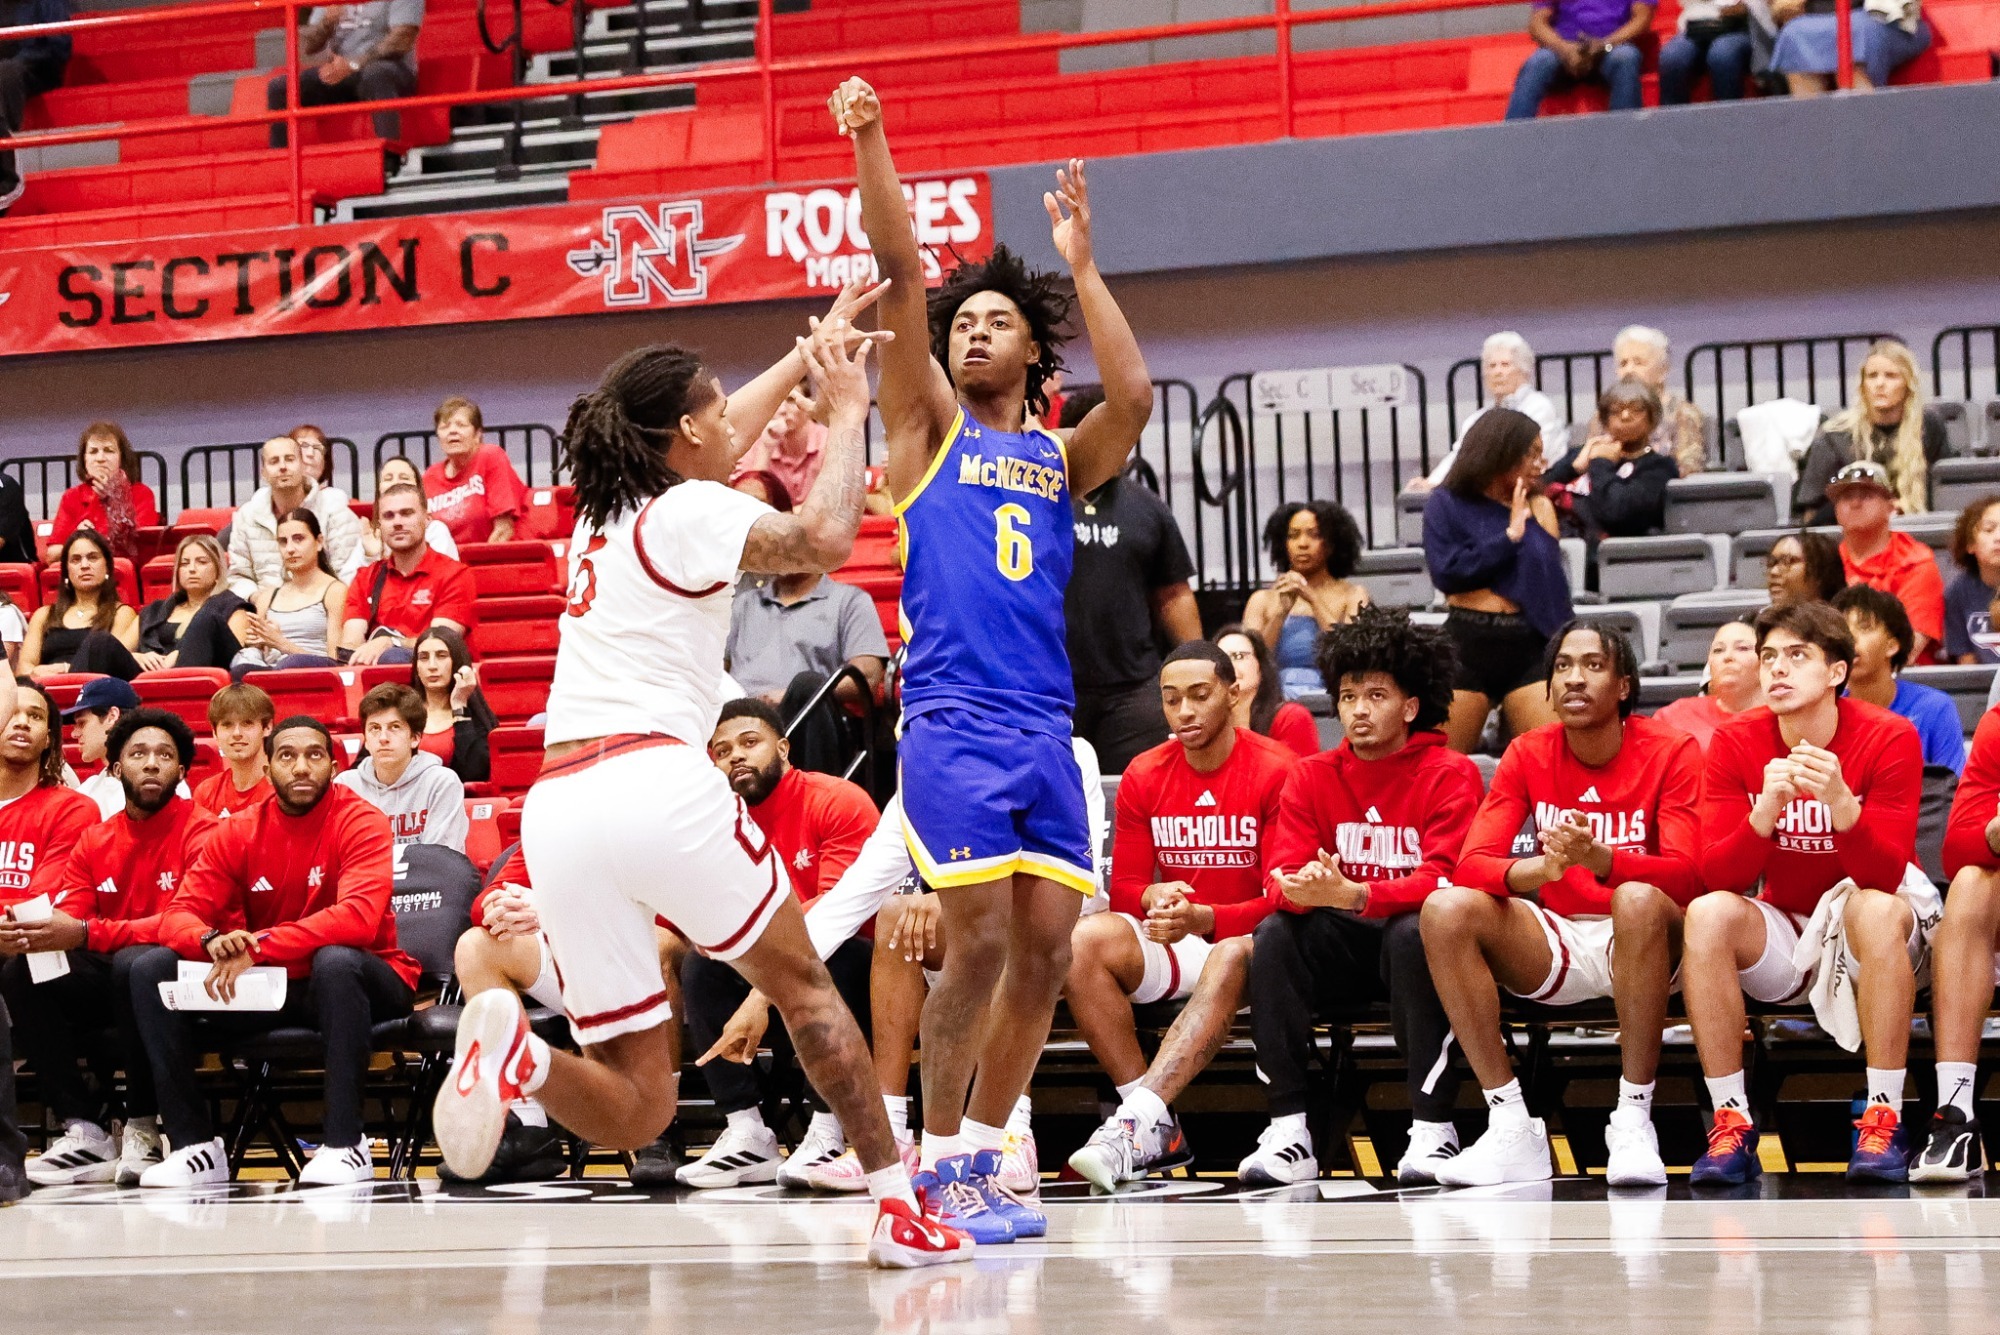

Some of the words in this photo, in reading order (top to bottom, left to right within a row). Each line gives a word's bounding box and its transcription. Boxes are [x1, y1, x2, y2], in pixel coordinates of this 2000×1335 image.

[57, 239, 421, 328] SECTION
[459, 232, 512, 298] C
[958, 453, 1064, 503] McNEESE
[993, 502, 1034, 582] 6
[1150, 815, 1257, 848] NICHOLLS
[1535, 801, 1647, 845] NICOLLS
[1165, 852, 1252, 866] BASKETBALL
[394, 899, 441, 913] YSTEM
